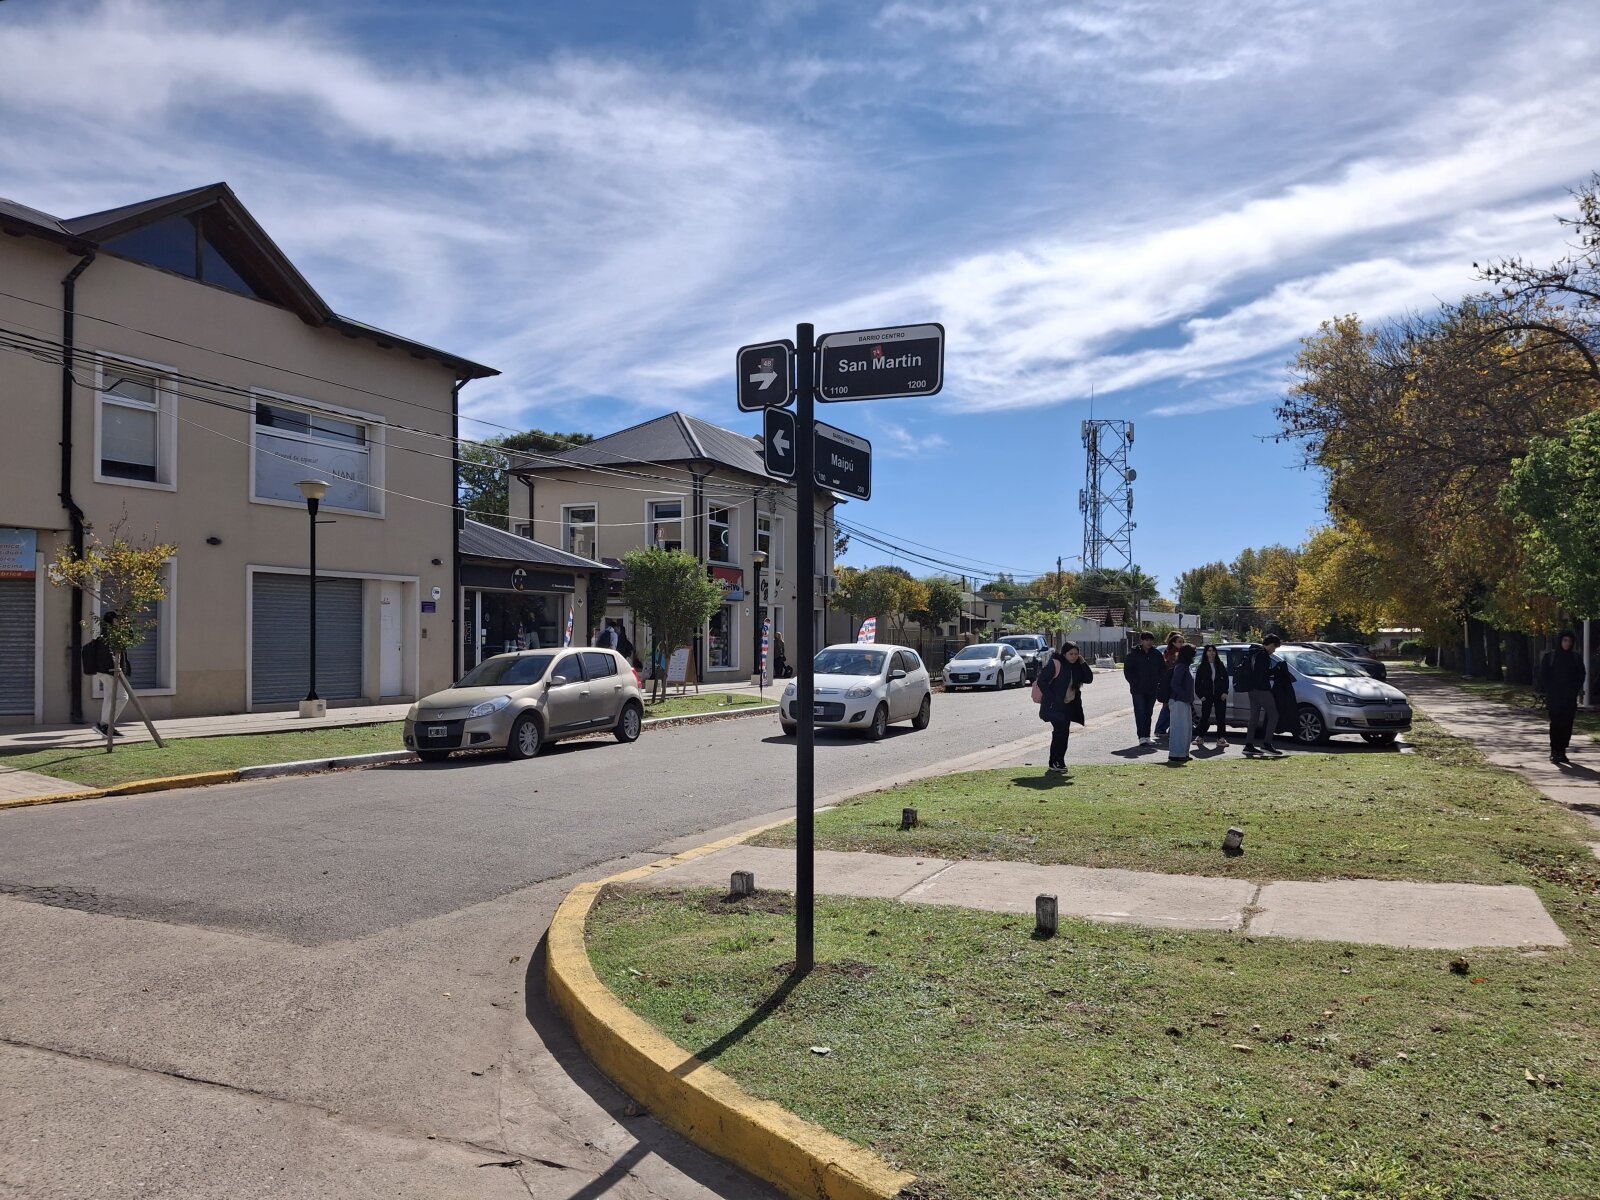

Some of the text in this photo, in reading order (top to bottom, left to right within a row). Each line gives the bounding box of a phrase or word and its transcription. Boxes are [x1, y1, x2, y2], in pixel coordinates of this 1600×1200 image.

[858, 332, 905, 342] BARRIO CENTRO
[838, 359, 867, 373] San
[907, 380, 927, 389] 1200
[830, 386, 848, 395] 1100
[831, 453, 854, 472] Maipú
